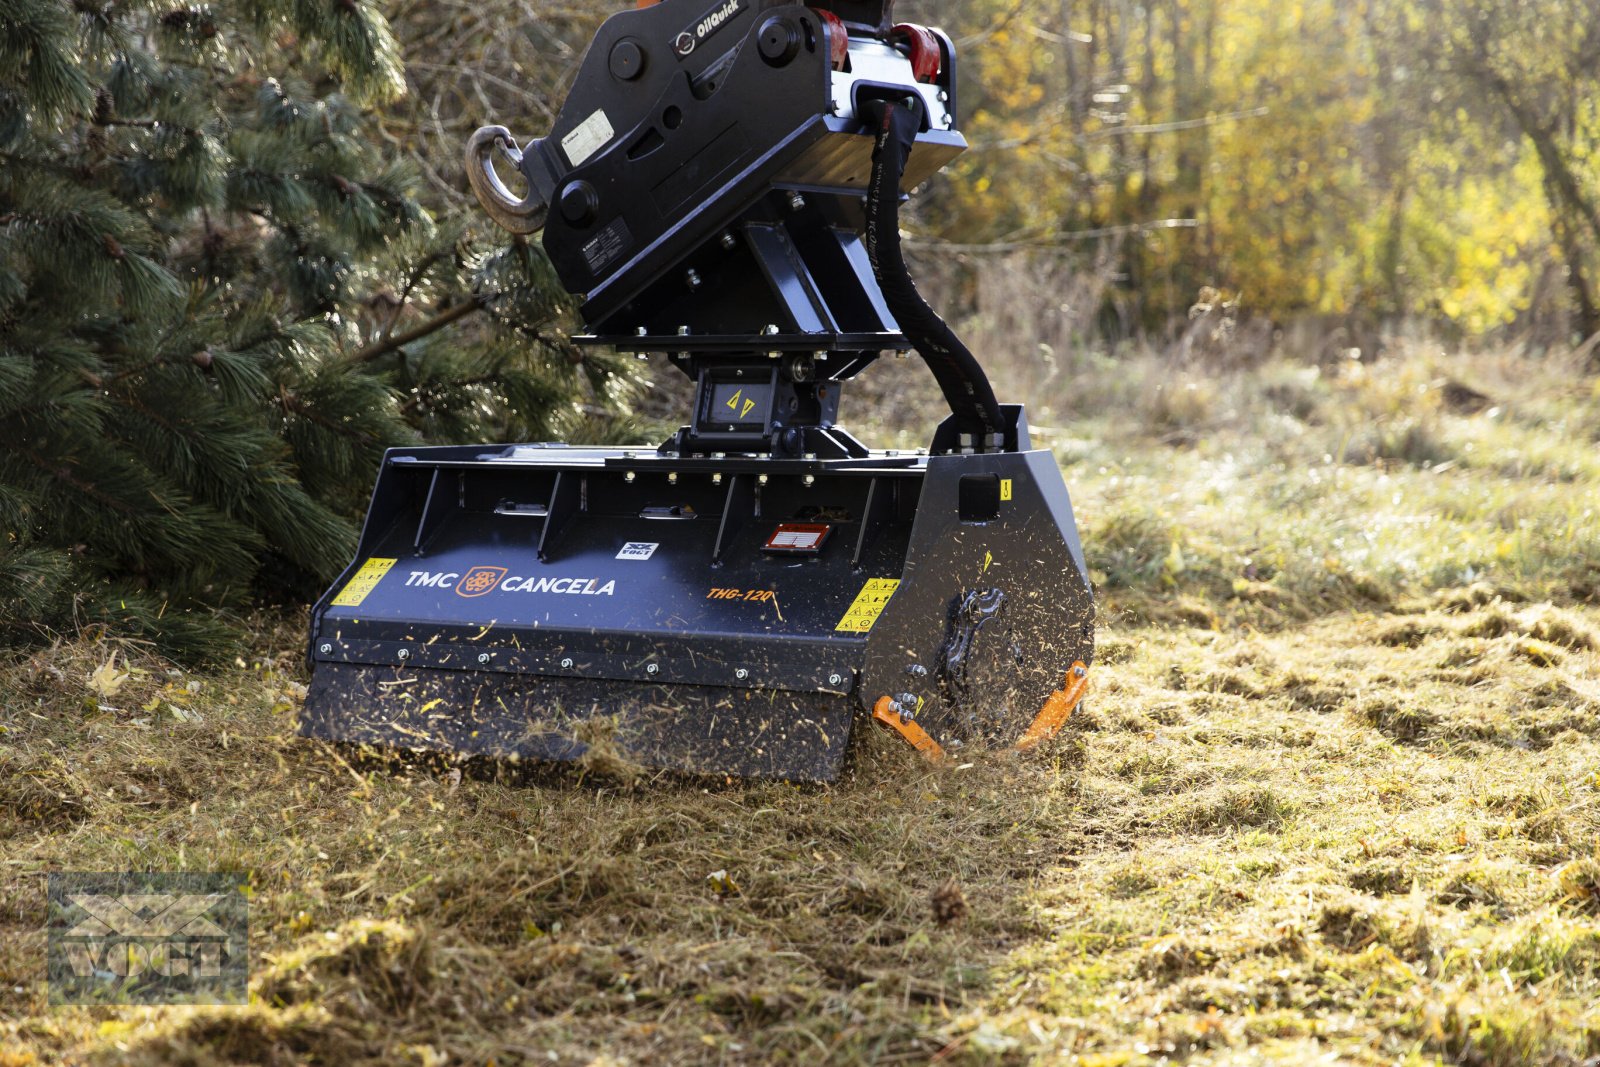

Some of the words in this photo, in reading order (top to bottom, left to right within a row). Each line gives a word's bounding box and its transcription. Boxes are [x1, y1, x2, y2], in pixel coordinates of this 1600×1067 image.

[697, 0, 739, 38] OilQuick
[405, 571, 459, 588] TMC
[501, 576, 616, 596] CANCELA
[706, 588, 774, 601] THG-120
